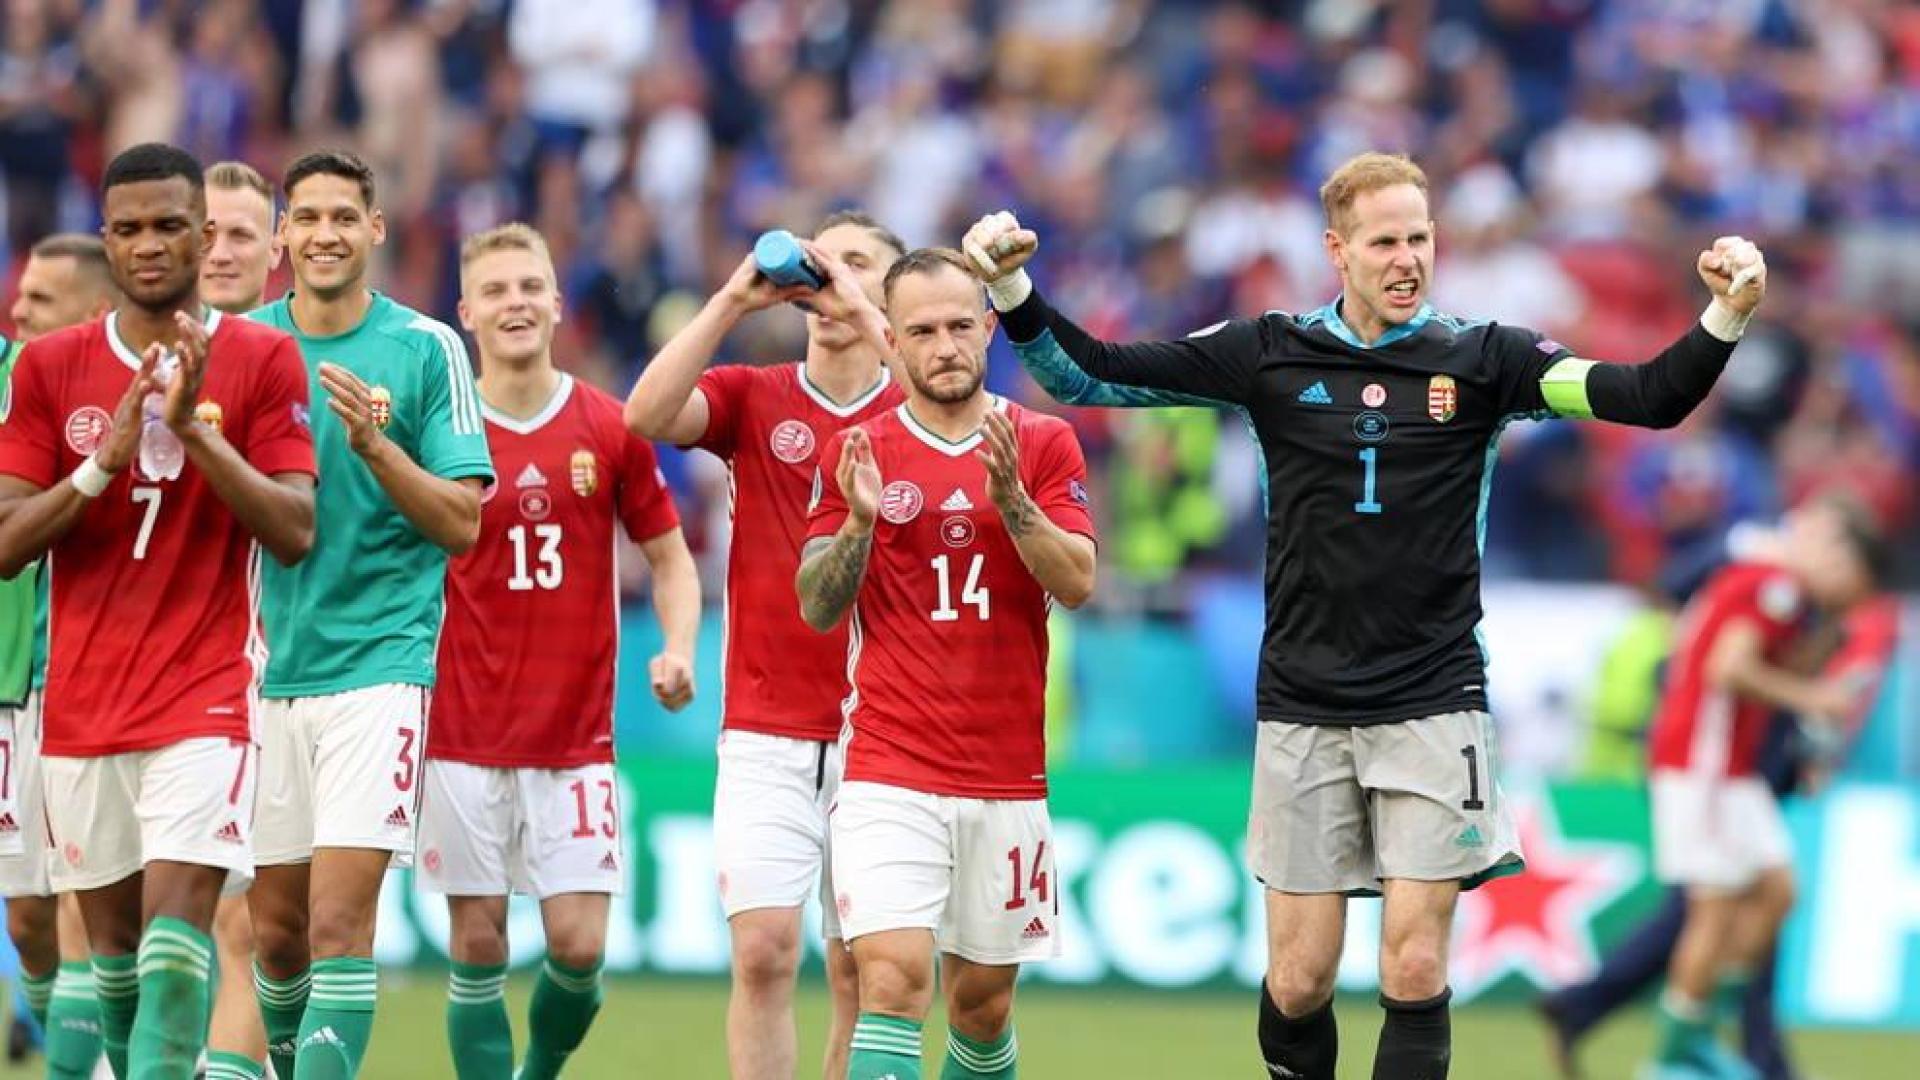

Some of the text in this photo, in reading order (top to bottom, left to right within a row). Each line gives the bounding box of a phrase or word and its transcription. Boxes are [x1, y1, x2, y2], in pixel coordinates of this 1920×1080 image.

[1355, 448, 1382, 513] 1
[131, 486, 162, 560] 7
[507, 523, 564, 591] 13
[930, 553, 991, 622] 14
[228, 737, 248, 805] 7
[393, 726, 415, 792] 3
[1461, 745, 1485, 811] 1
[569, 779, 617, 839] 13
[1005, 840, 1048, 911] 14
